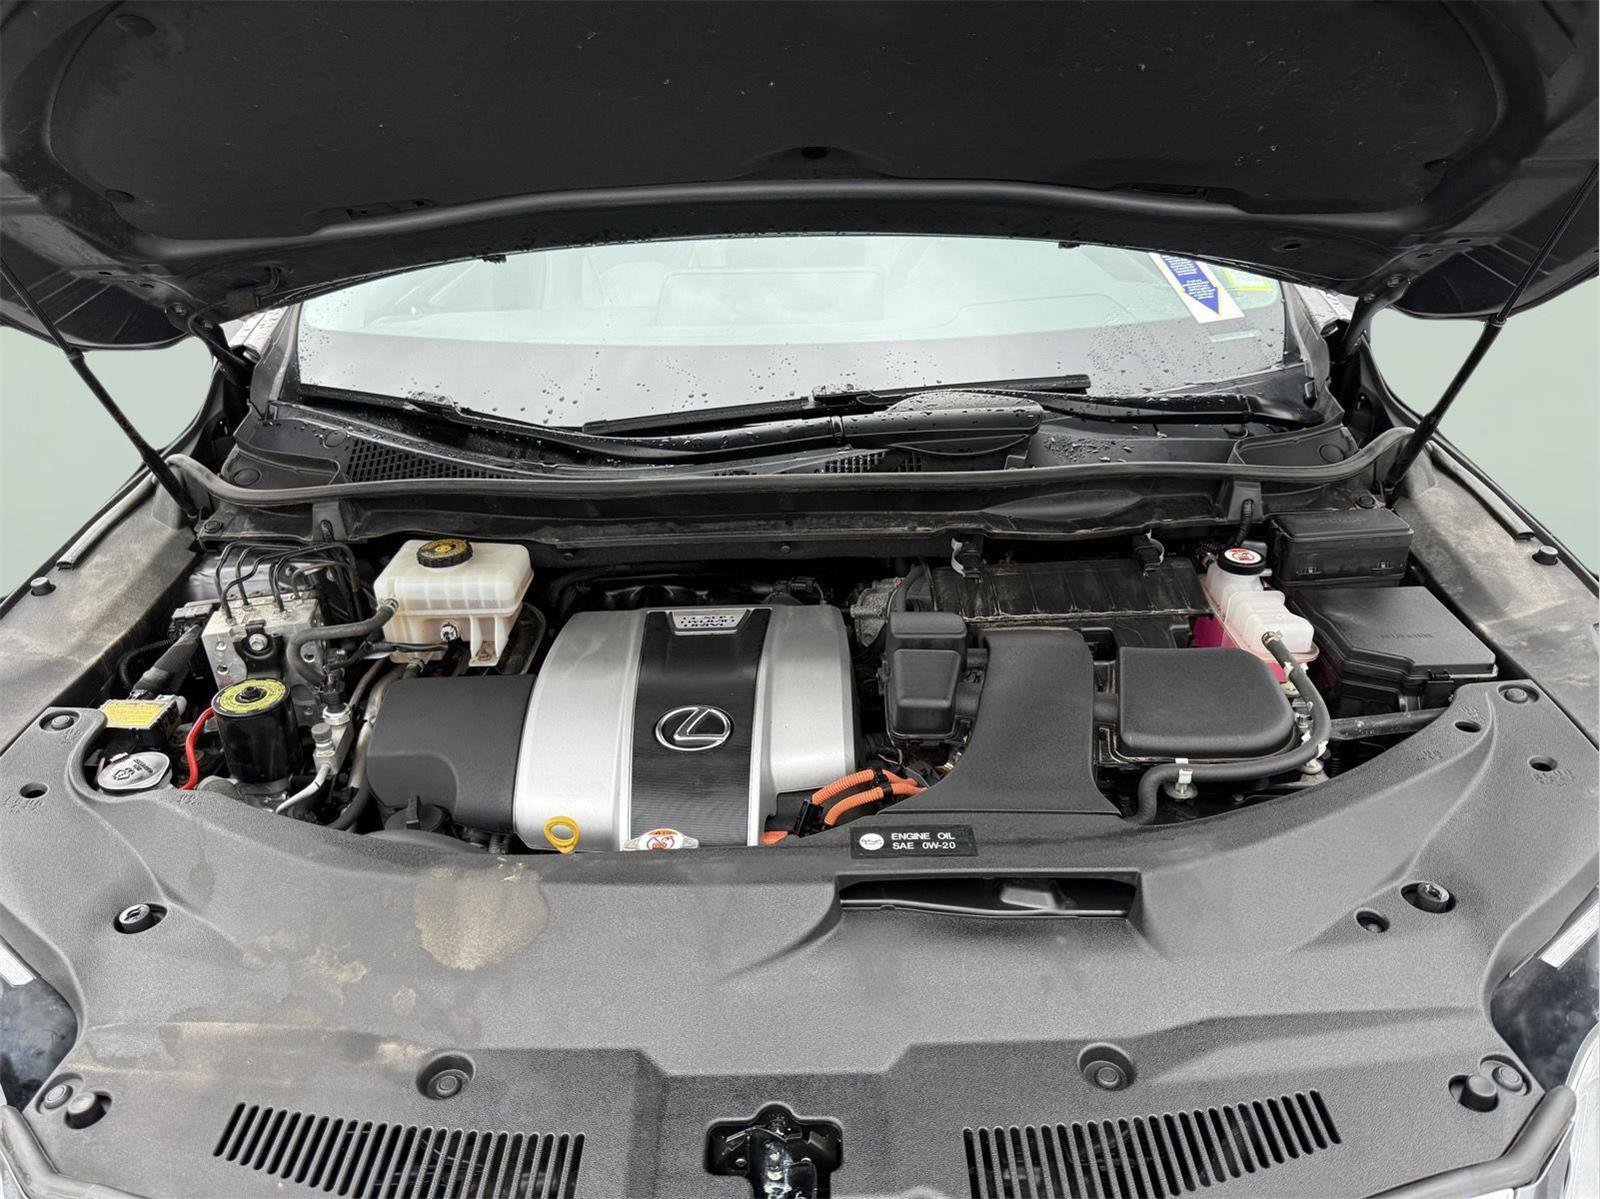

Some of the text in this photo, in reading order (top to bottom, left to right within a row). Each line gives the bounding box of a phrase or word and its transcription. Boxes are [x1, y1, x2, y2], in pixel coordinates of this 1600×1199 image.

[891, 832, 956, 840] ENGINE OIL
[922, 841, 956, 849] 0W-20
